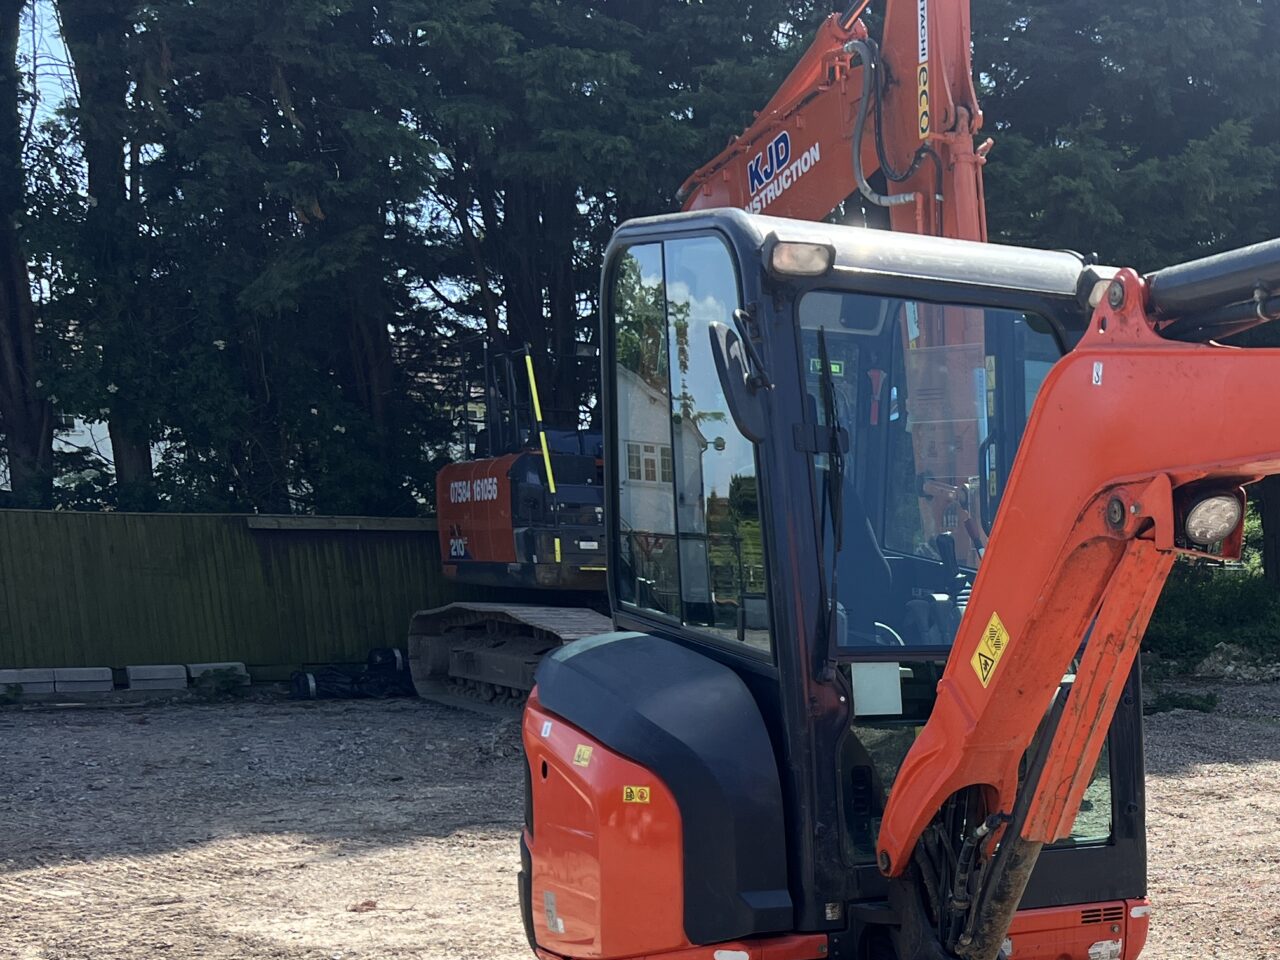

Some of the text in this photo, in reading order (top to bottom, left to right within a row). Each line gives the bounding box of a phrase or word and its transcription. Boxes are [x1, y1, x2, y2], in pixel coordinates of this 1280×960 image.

[919, 0, 927, 58] ITACHI
[744, 142, 821, 214] NSTRUCTION
[747, 130, 791, 196] KJD
[450, 477, 498, 503] 07584 161056
